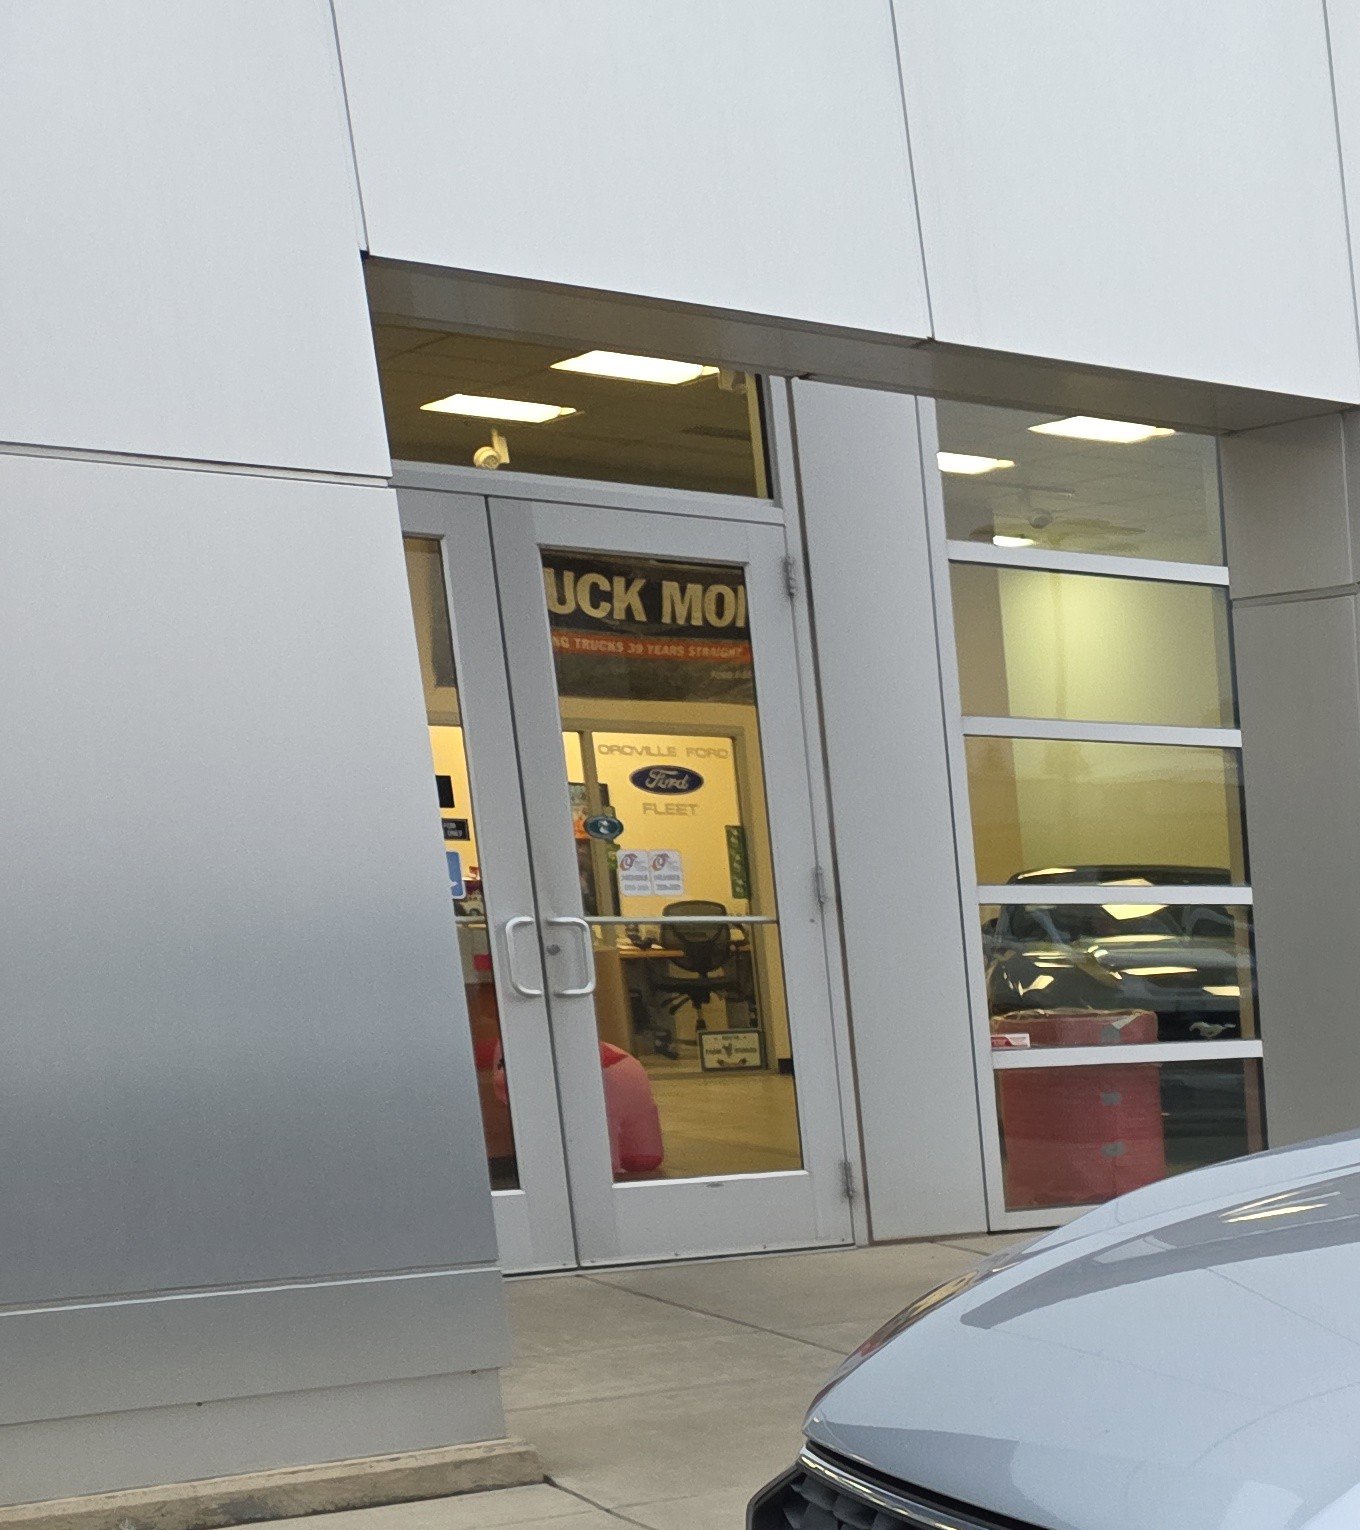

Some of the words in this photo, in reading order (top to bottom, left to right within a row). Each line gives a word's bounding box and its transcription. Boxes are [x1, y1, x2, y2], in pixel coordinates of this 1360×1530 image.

[573, 638, 624, 653] TRUCKS
[646, 643, 685, 658] YEARS
[597, 743, 678, 758] OROVILLE
[686, 746, 729, 760] FORD
[645, 768, 690, 790] Ford
[642, 802, 699, 816] FLEET
